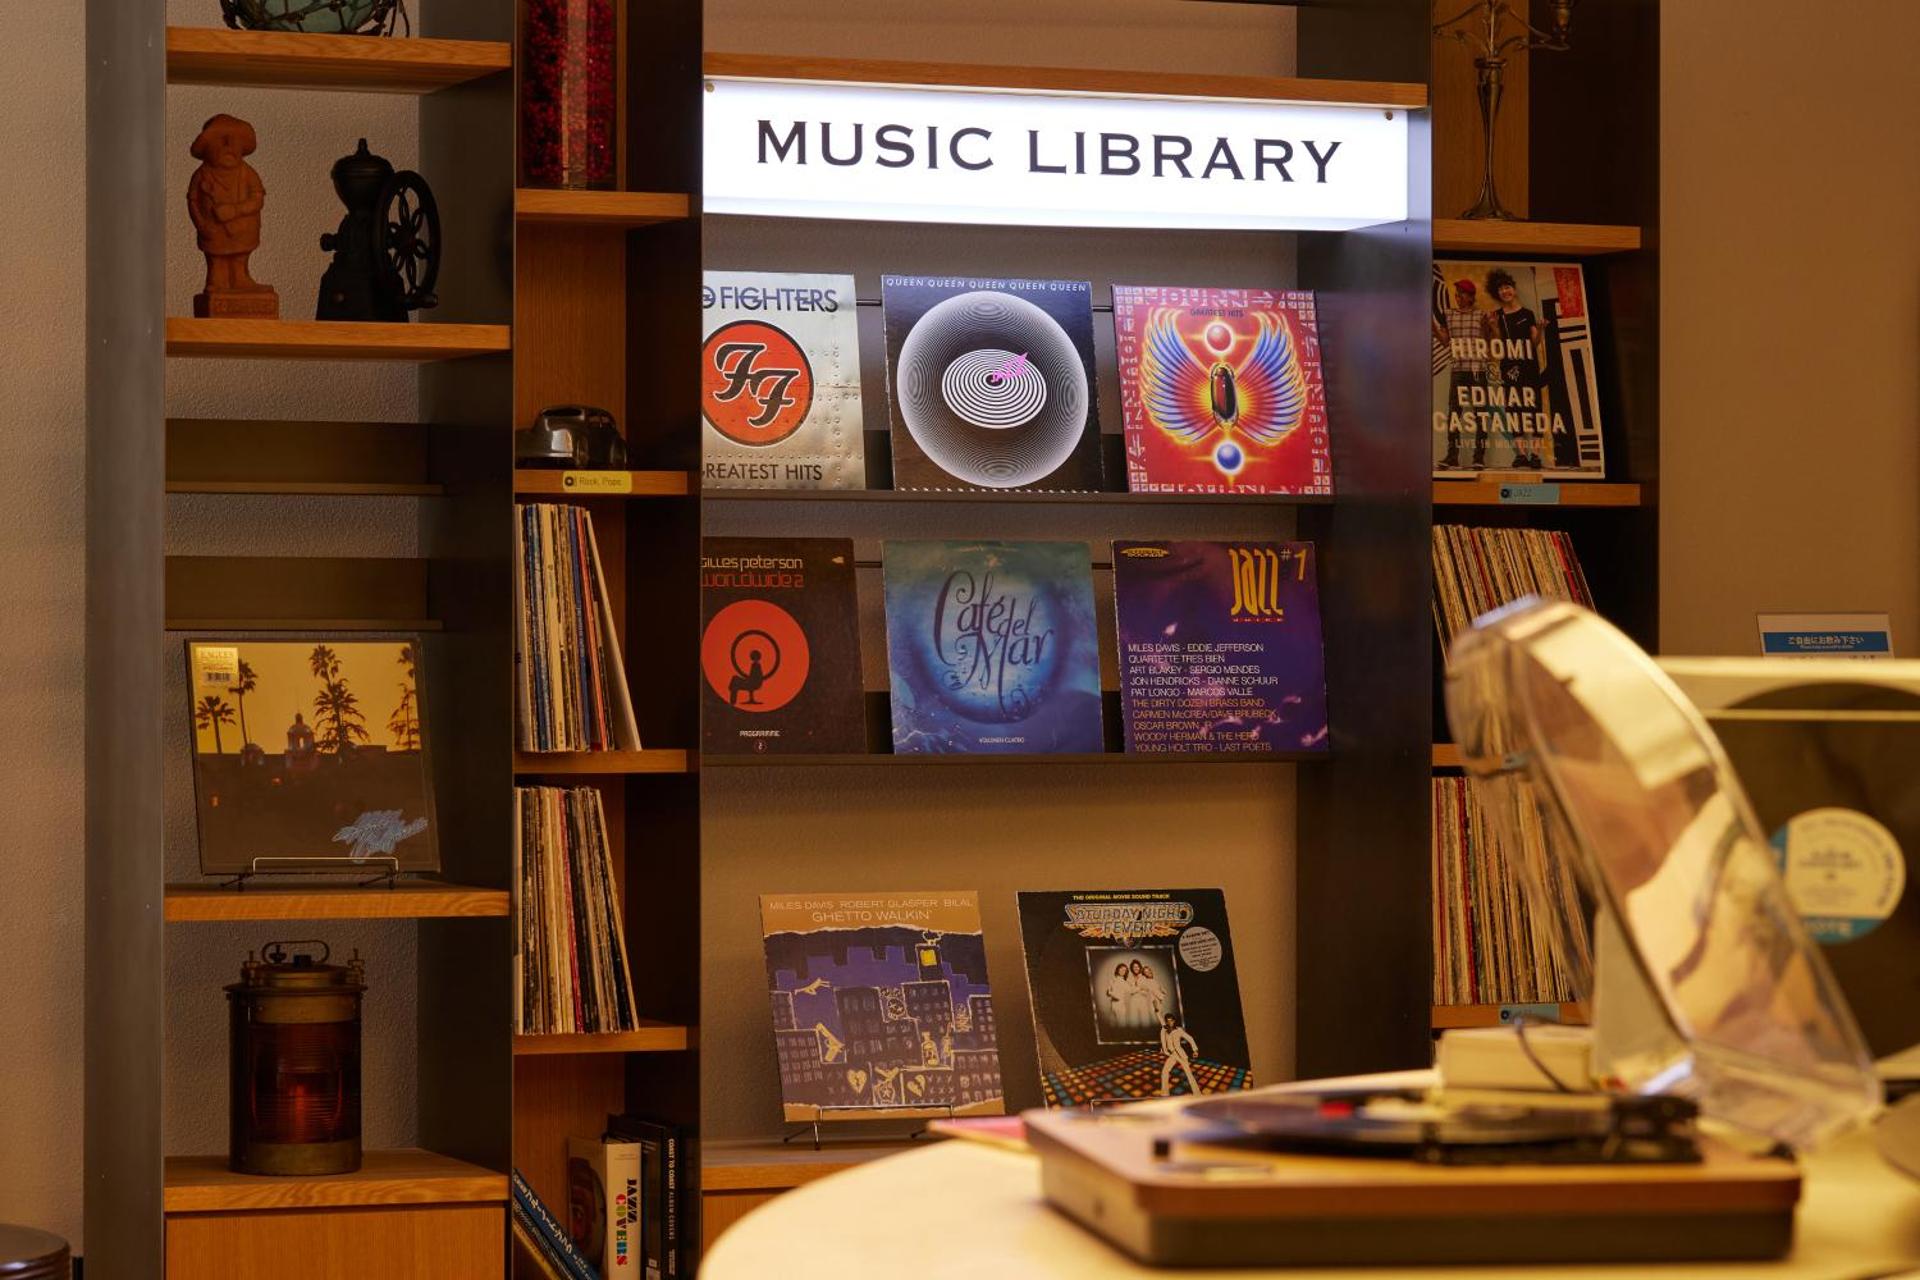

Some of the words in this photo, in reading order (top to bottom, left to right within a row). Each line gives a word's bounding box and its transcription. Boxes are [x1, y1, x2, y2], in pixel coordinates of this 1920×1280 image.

[755, 119, 995, 172] MUSIC
[1026, 128, 1344, 185] LIBRARY
[886, 278, 924, 288] QUEEN
[927, 279, 965, 289] QUEEN
[968, 280, 1005, 290] QUEEN
[1009, 281, 1046, 291] QUEEN
[1049, 283, 1087, 292] QUEEN
[719, 286, 839, 313] FIGHTERS
[1451, 337, 1534, 361] HIROMI
[1456, 385, 1537, 408] EDMAR
[1432, 410, 1568, 434] CASTANEDA
[703, 462, 779, 480] REATEST
[785, 464, 823, 481] HITS
[739, 555, 804, 573] peterson
[1128, 643, 1154, 653] MILES
[1155, 643, 1180, 653] DAVIS
[1187, 643, 1213, 653] EDDIE
[1214, 643, 1265, 653] JEFFERSON
[1128, 655, 1180, 664] QUARTETTE
[1181, 655, 1204, 664] TRES
[1205, 655, 1226, 664] BIEN
[1129, 665, 1146, 675] ART
[1148, 665, 1183, 675] BLAKEY
[1189, 665, 1222, 675] SERGIO
[1223, 665, 1261, 675] MENDES
[1130, 676, 1149, 686] JON
[1150, 676, 1201, 686] HENDRICKS
[1207, 676, 1240, 686] DIANNE
[1240, 676, 1279, 686] SCHUUR
[1130, 687, 1147, 697] PAT
[1148, 687, 1180, 697] LONGO
[1187, 687, 1226, 697] MARCOS
[1227, 687, 1254, 697] VALLE
[1132, 698, 1149, 708] THE
[1151, 698, 1176, 708] DIRTY
[1177, 698, 1208, 708] DOZEN
[1209, 698, 1239, 708] BRASS
[1240, 698, 1266, 708] BAND
[1132, 709, 1171, 719] CARMEN
[1133, 720, 1165, 730] OSCAR
[1134, 731, 1168, 742] WOODY
[1169, 731, 1207, 742] HERMAN
[769, 902, 802, 911] MILES
[804, 901, 834, 910] DAVIS
[839, 900, 882, 910] ROBERT
[887, 899, 938, 909] GLASPER
[943, 898, 975, 908] BILAL
[812, 910, 873, 923] GHETTO
[1102, 920, 1155, 934] FEVER
[627, 1178, 639, 1224] JAZZ
[615, 1193, 629, 1266] COVERS
